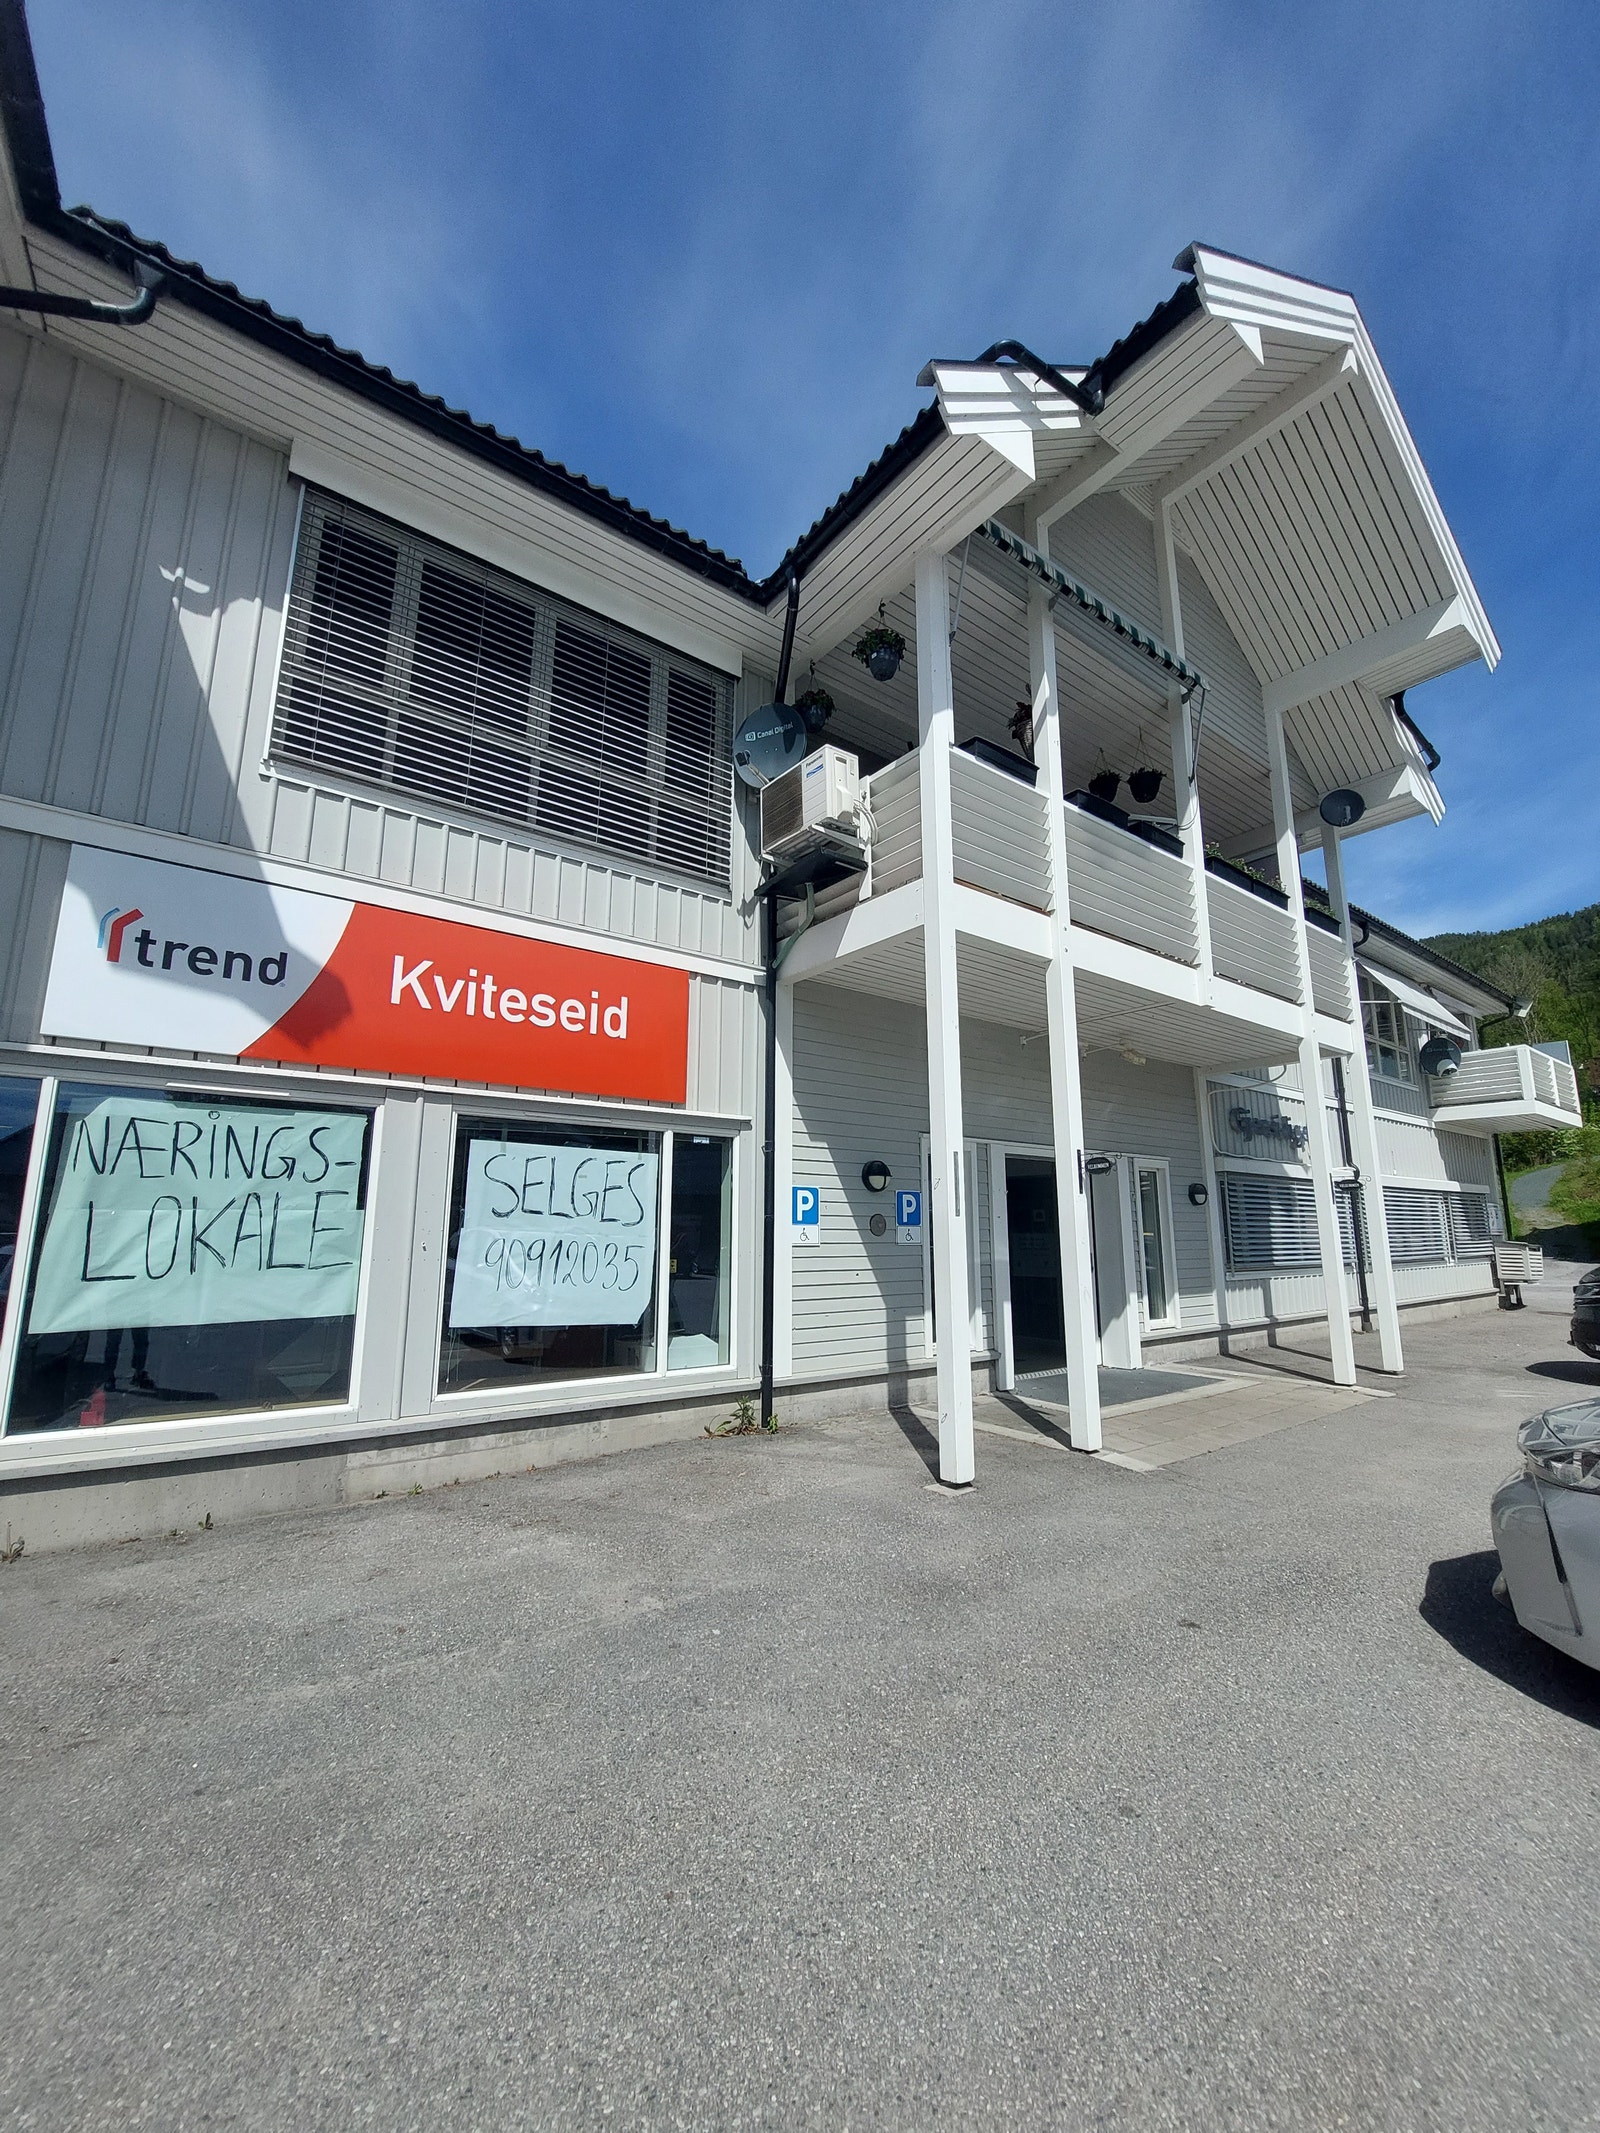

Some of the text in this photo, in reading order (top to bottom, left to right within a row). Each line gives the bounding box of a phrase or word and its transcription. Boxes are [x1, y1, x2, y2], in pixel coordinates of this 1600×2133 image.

[757, 727, 774, 739] Canal
[134, 929, 289, 986] trend
[390, 955, 629, 1039] Kviteseid
[484, 1154, 645, 1227] SELGES
[796, 1190, 815, 1222] P
[902, 1194, 917, 1223] P
[81, 1191, 353, 1282] LOKALE
[485, 1238, 645, 1292] 90912035
